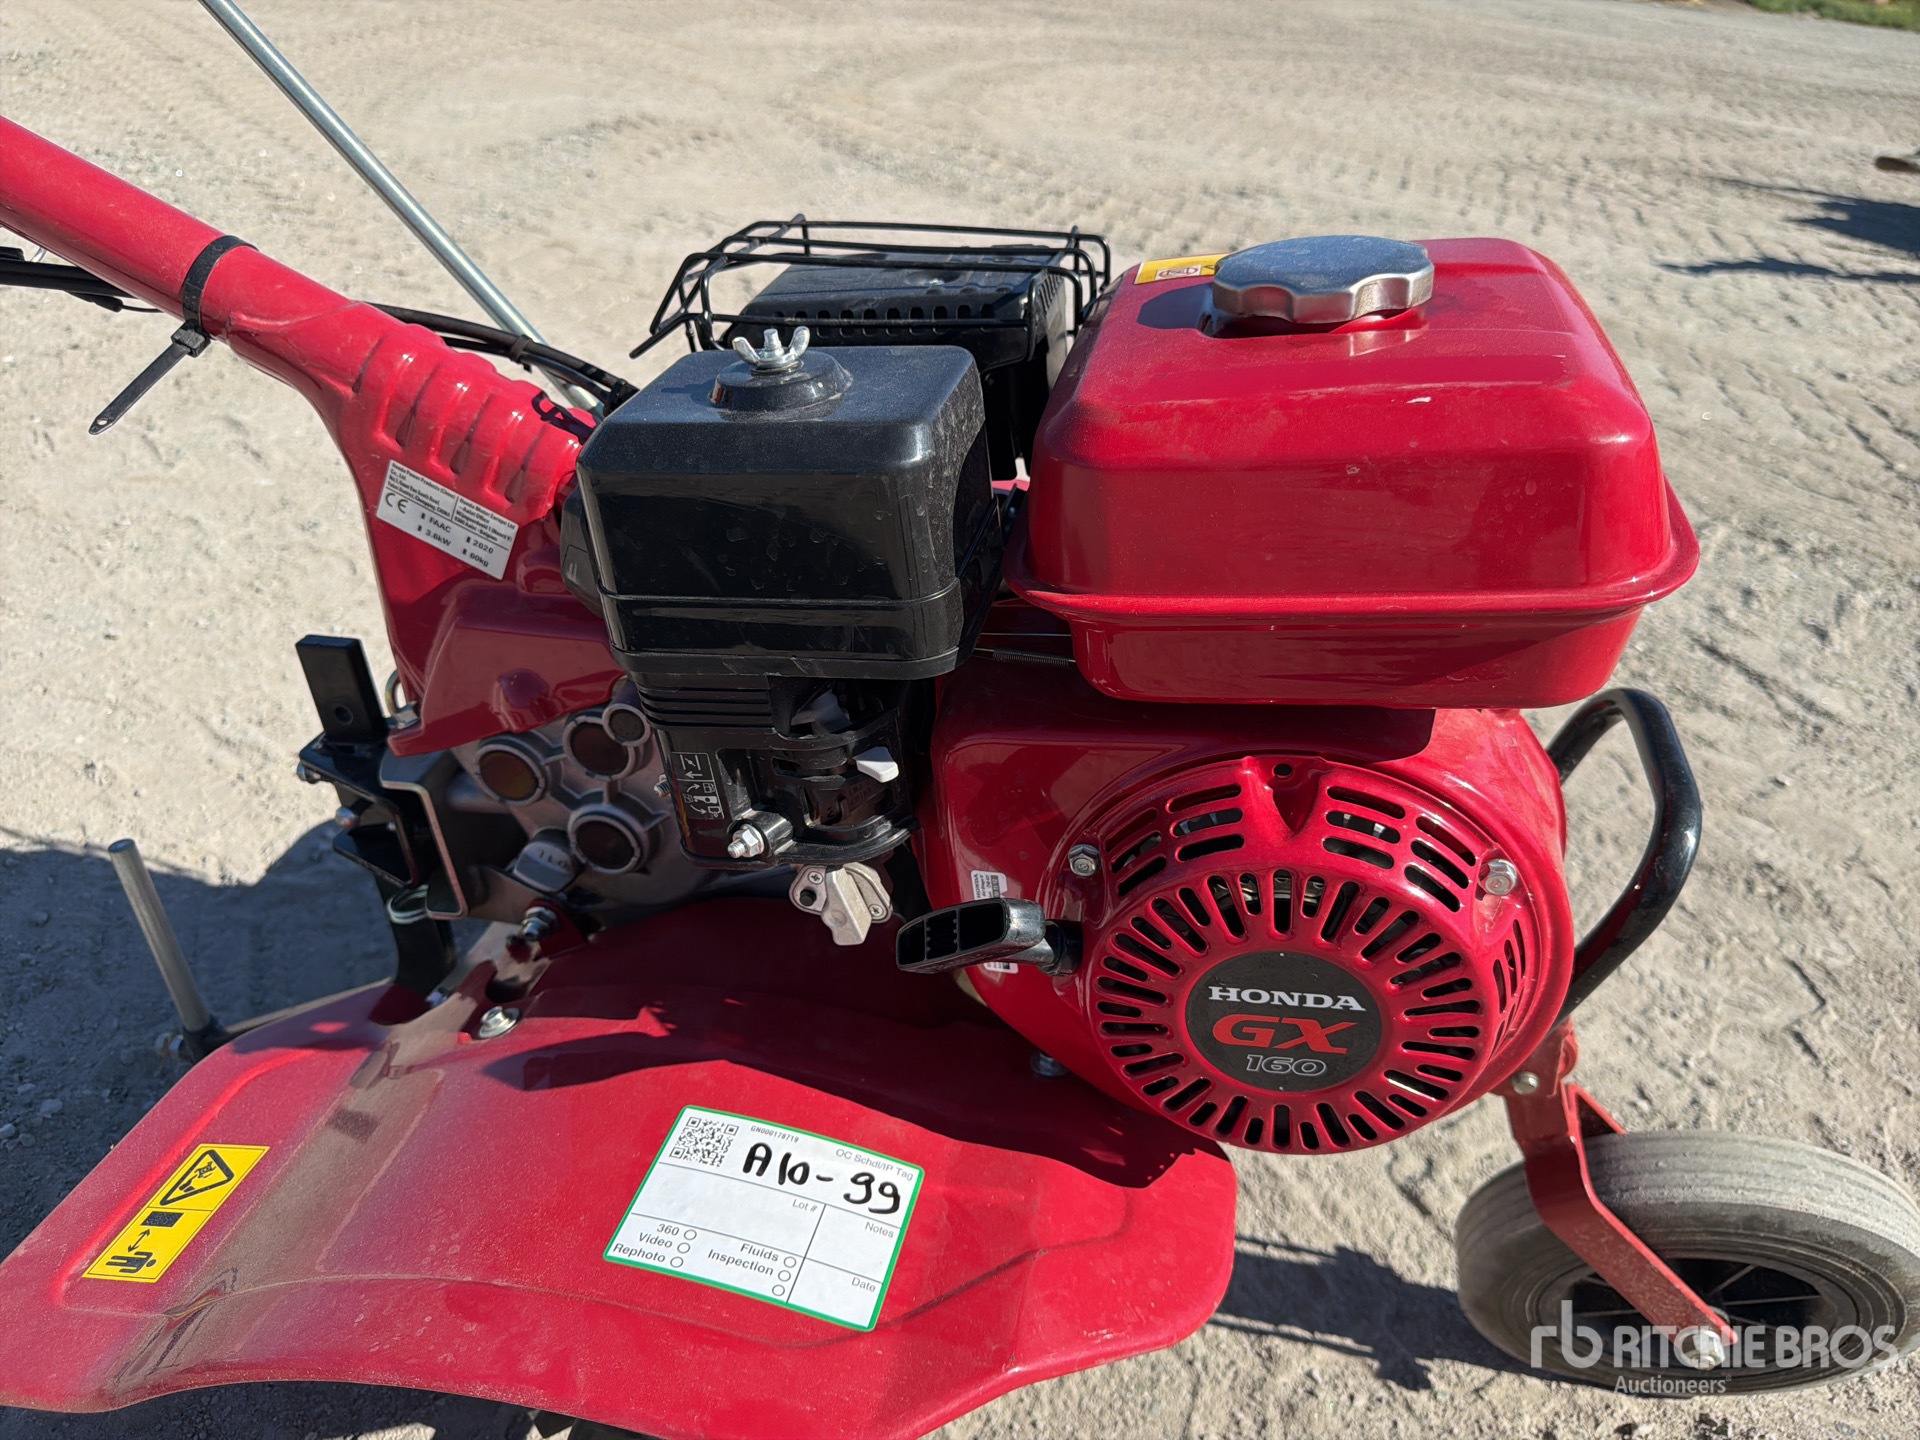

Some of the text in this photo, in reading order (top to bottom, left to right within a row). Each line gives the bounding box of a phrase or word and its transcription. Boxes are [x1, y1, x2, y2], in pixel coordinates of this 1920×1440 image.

[429, 517, 452, 533] FAAC
[425, 529, 451, 546] 3.6kW
[473, 539, 494, 554] 2020
[470, 554, 489, 567] 60kg
[1208, 986, 1367, 1011] HONDA
[1212, 1014, 1357, 1054] GX
[1246, 1054, 1326, 1076] 160
[835, 1148, 852, 1160] OC
[895, 1167, 914, 1182] Tag
[792, 1199, 818, 1213] Lot #
[656, 1224, 680, 1236] 360
[864, 1221, 895, 1238] Notes
[638, 1232, 673, 1249] Video
[613, 1244, 666, 1264] Rephoto
[740, 1243, 779, 1262] Fluids
[707, 1249, 774, 1276] Inspection
[851, 1276, 876, 1292] Date
